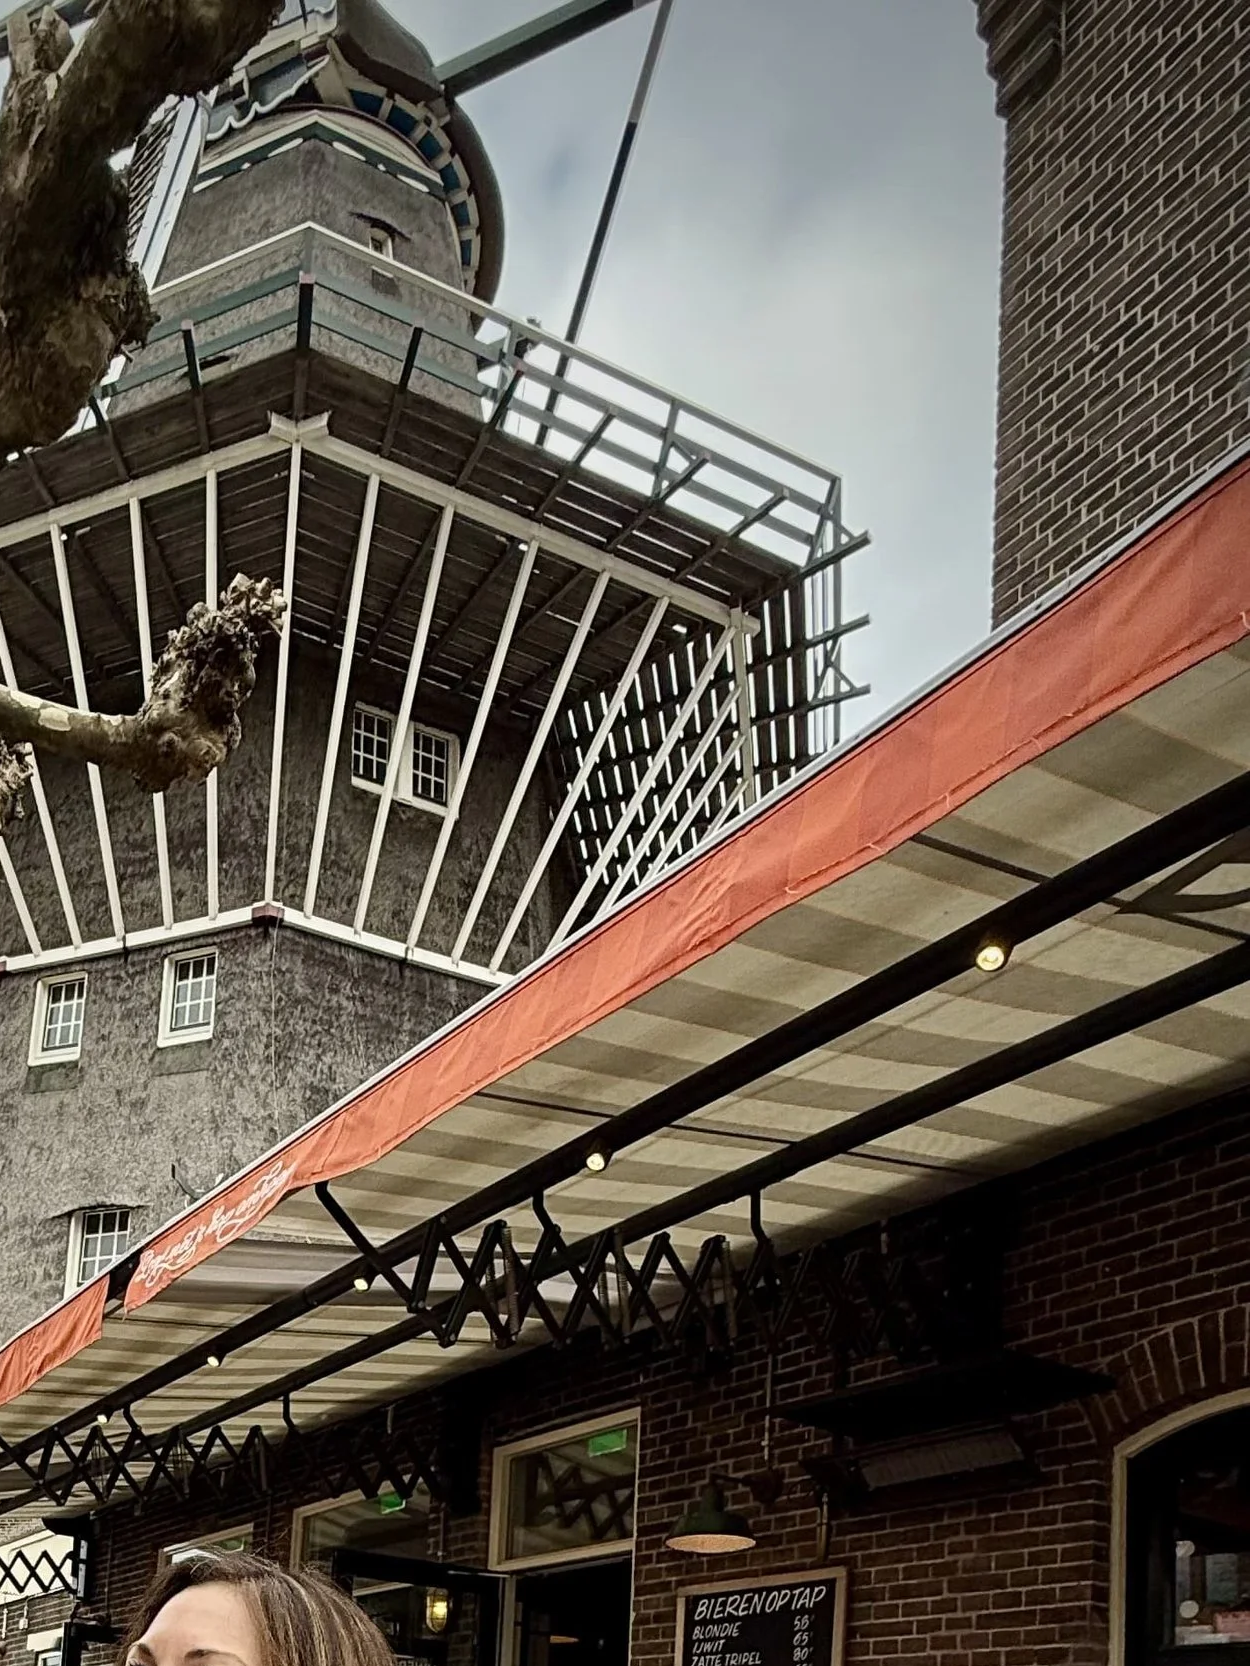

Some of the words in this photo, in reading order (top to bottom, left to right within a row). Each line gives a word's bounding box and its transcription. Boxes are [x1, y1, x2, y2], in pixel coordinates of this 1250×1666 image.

[694, 1591, 766, 1621] BIEREN
[765, 1589, 791, 1613] OP
[791, 1585, 827, 1611] TAP
[692, 1621, 743, 1641] BLONDIE
[692, 1639, 726, 1655] IJWIT
[724, 1651, 762, 1666] TRIPEL
